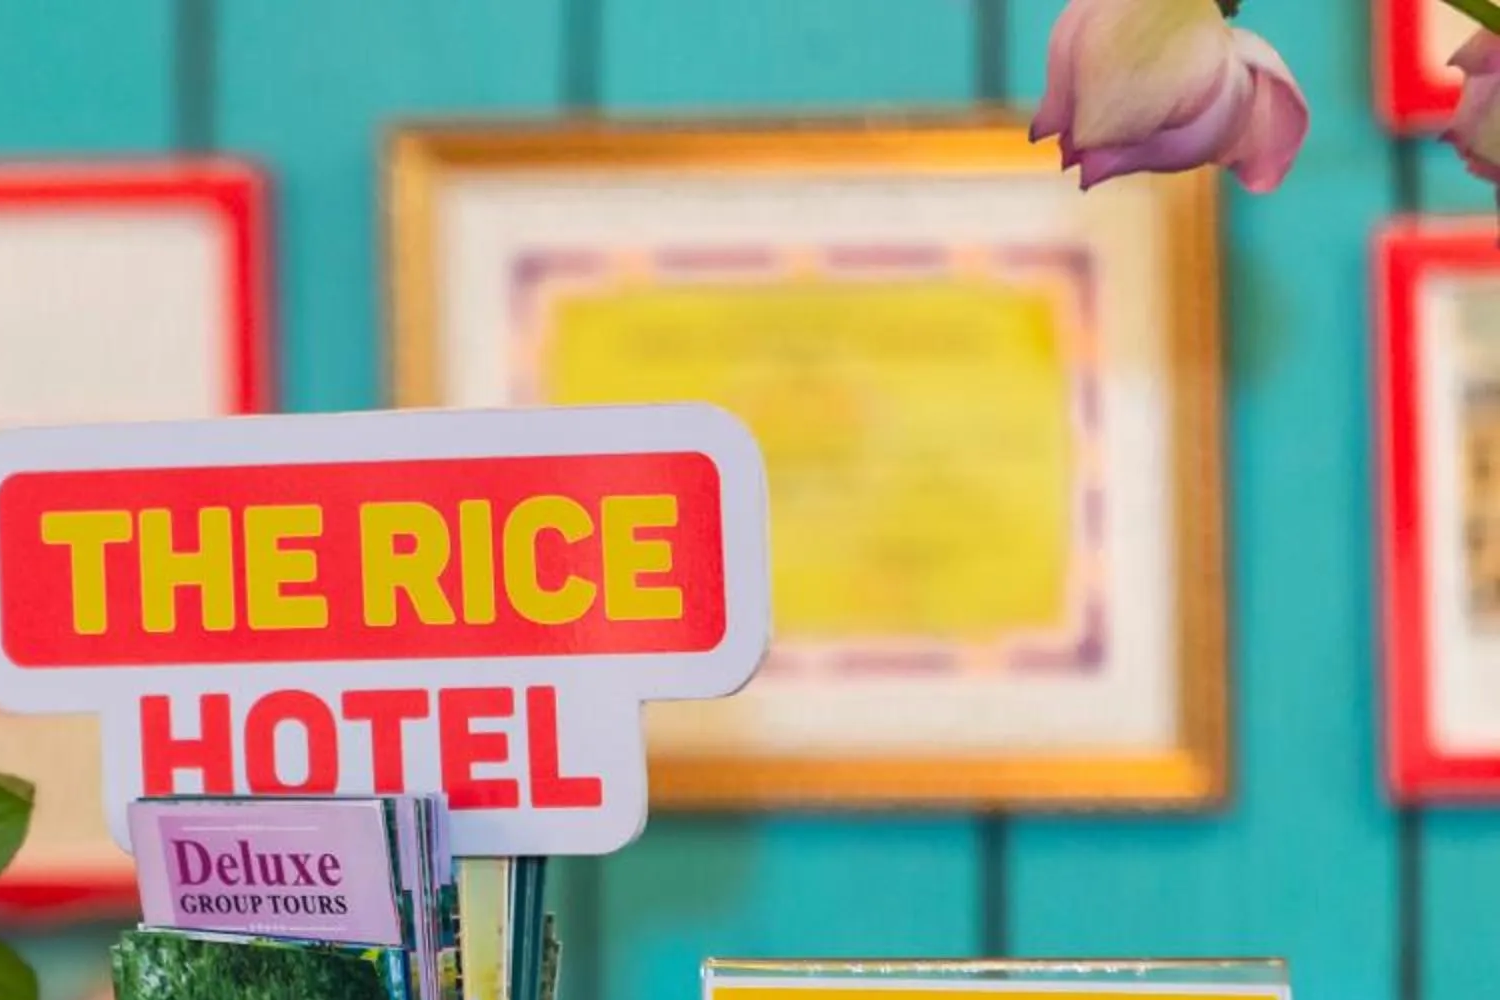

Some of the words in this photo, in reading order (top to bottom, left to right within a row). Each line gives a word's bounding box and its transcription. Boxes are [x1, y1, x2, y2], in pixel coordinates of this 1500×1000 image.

[41, 504, 328, 634] THE
[360, 494, 683, 627] RICE
[140, 686, 603, 809] HOTEL
[171, 839, 342, 887] Deluxe
[180, 894, 262, 914] GROUP
[267, 895, 348, 915] TOURS
